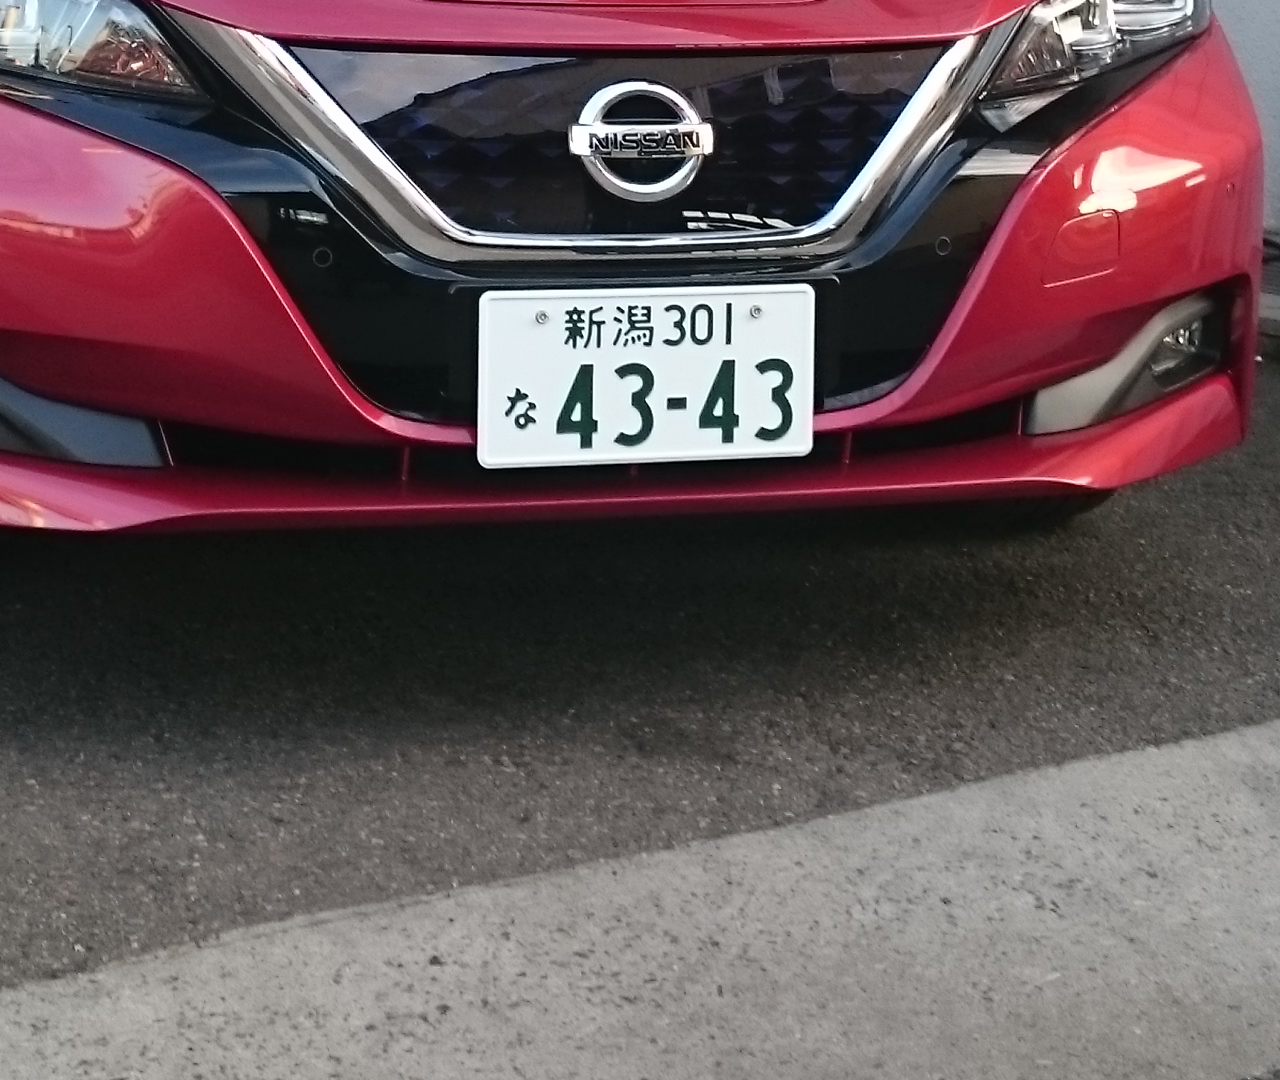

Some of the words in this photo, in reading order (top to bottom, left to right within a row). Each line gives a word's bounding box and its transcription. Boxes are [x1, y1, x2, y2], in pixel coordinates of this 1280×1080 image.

[588, 130, 702, 151] NISSAN
[504, 387, 538, 430] な
[555, 358, 794, 449] 43-43
